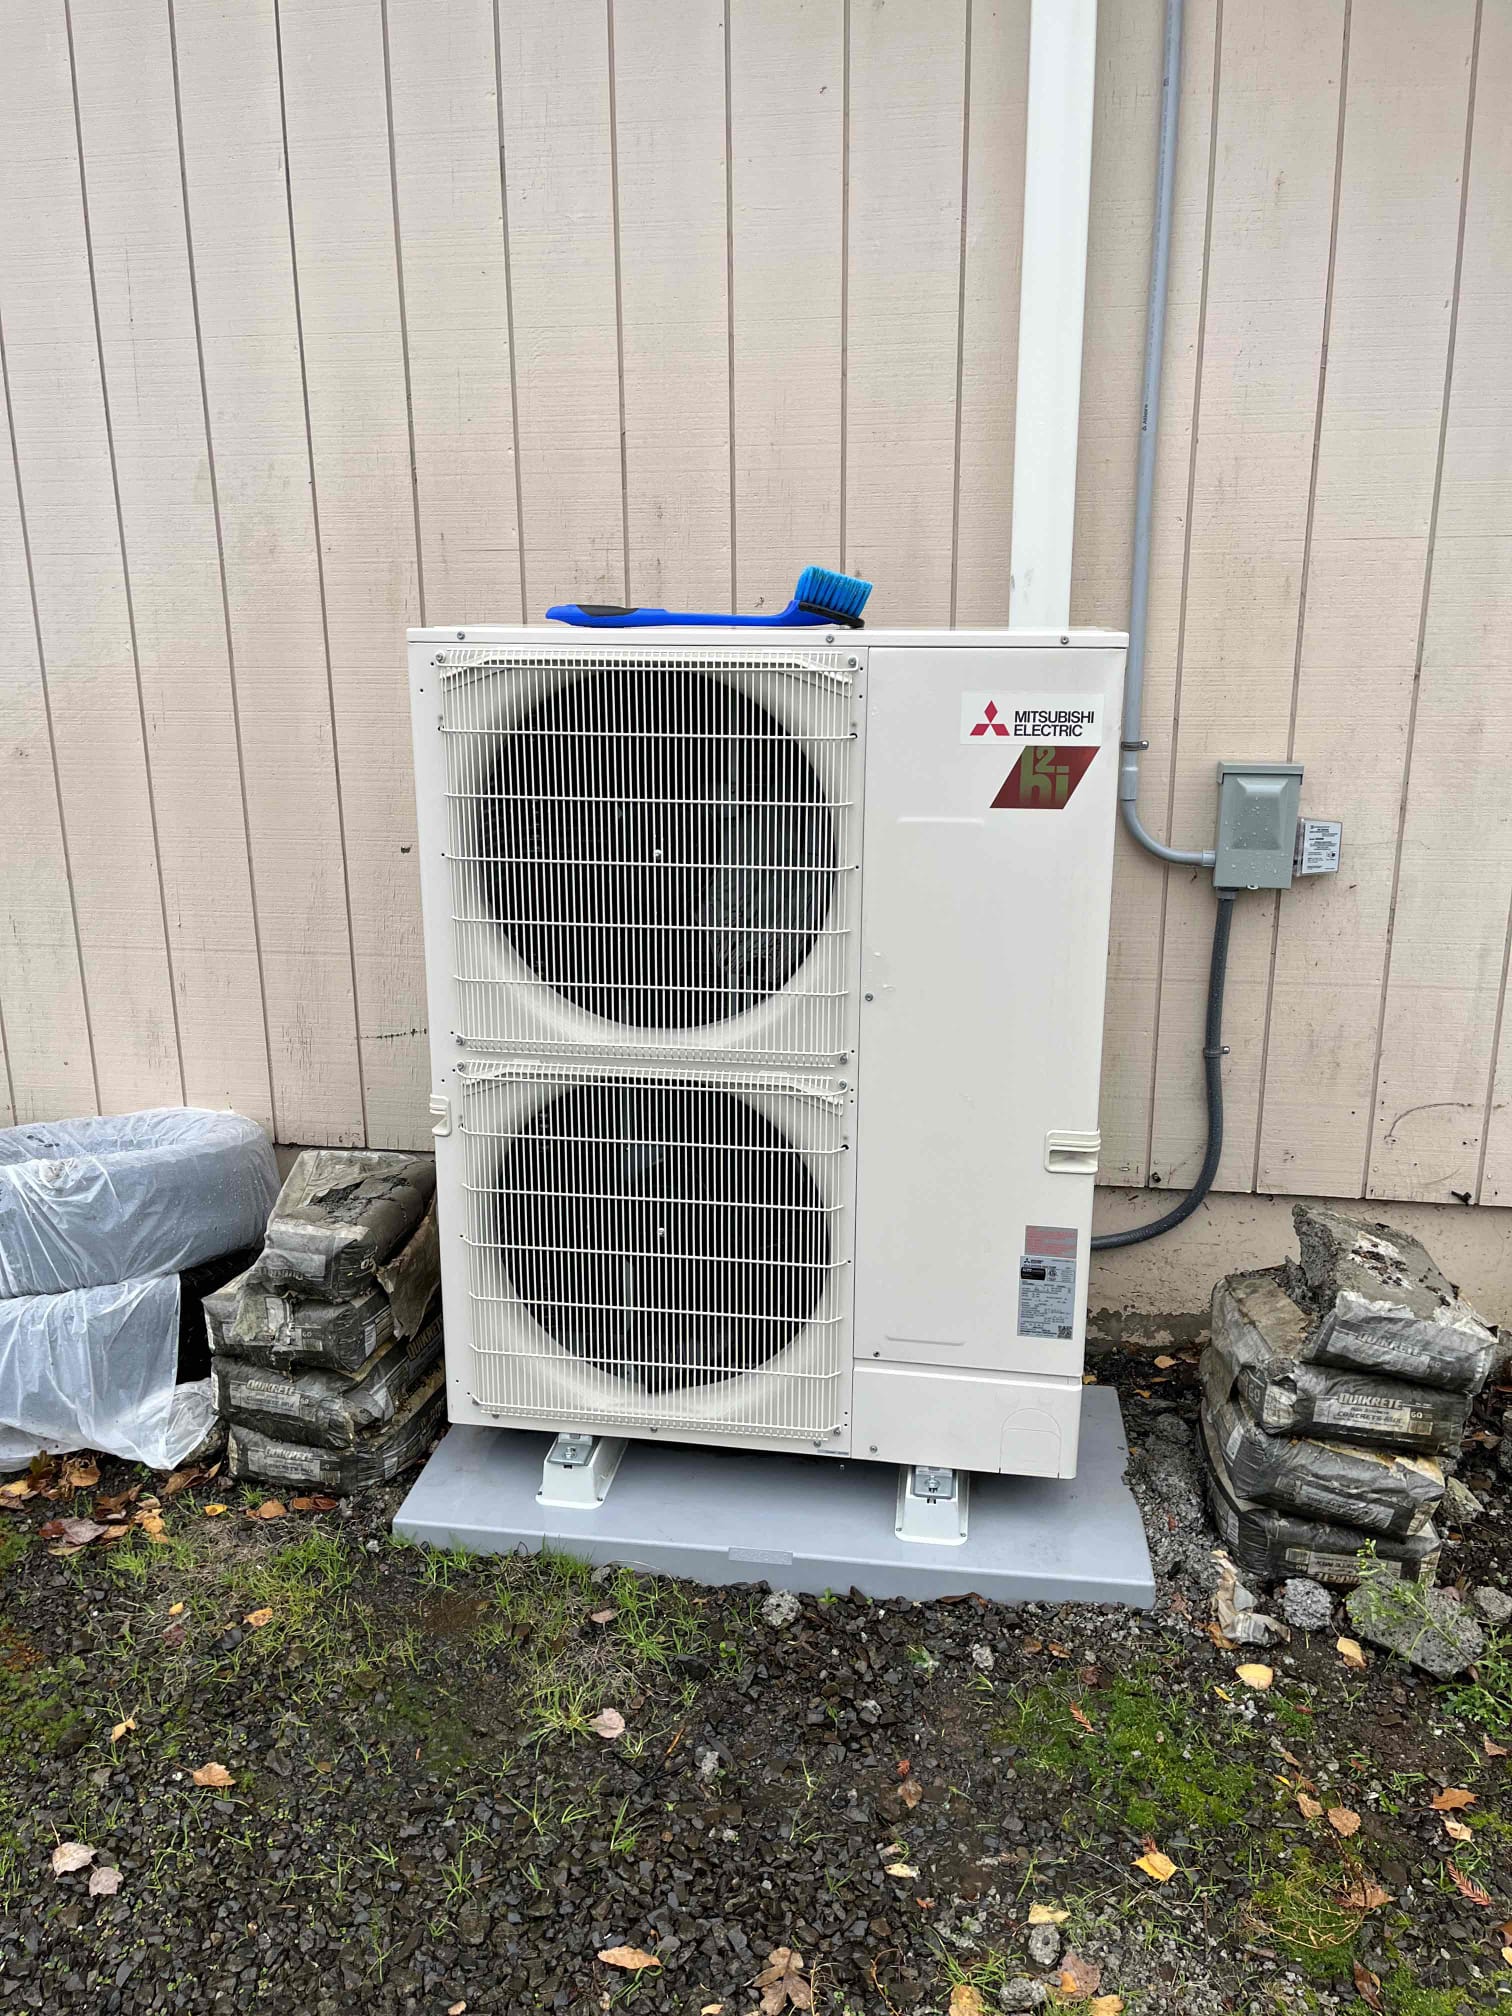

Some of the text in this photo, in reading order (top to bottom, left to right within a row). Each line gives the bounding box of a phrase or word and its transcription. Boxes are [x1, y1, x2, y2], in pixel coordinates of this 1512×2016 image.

[1014, 710, 1095, 724] MITSUBISHI
[1014, 724, 1083, 737] ELECTRIC
[246, 1379, 297, 1395] QUIKRETE
[1337, 1392, 1403, 1410] QUIKRETE
